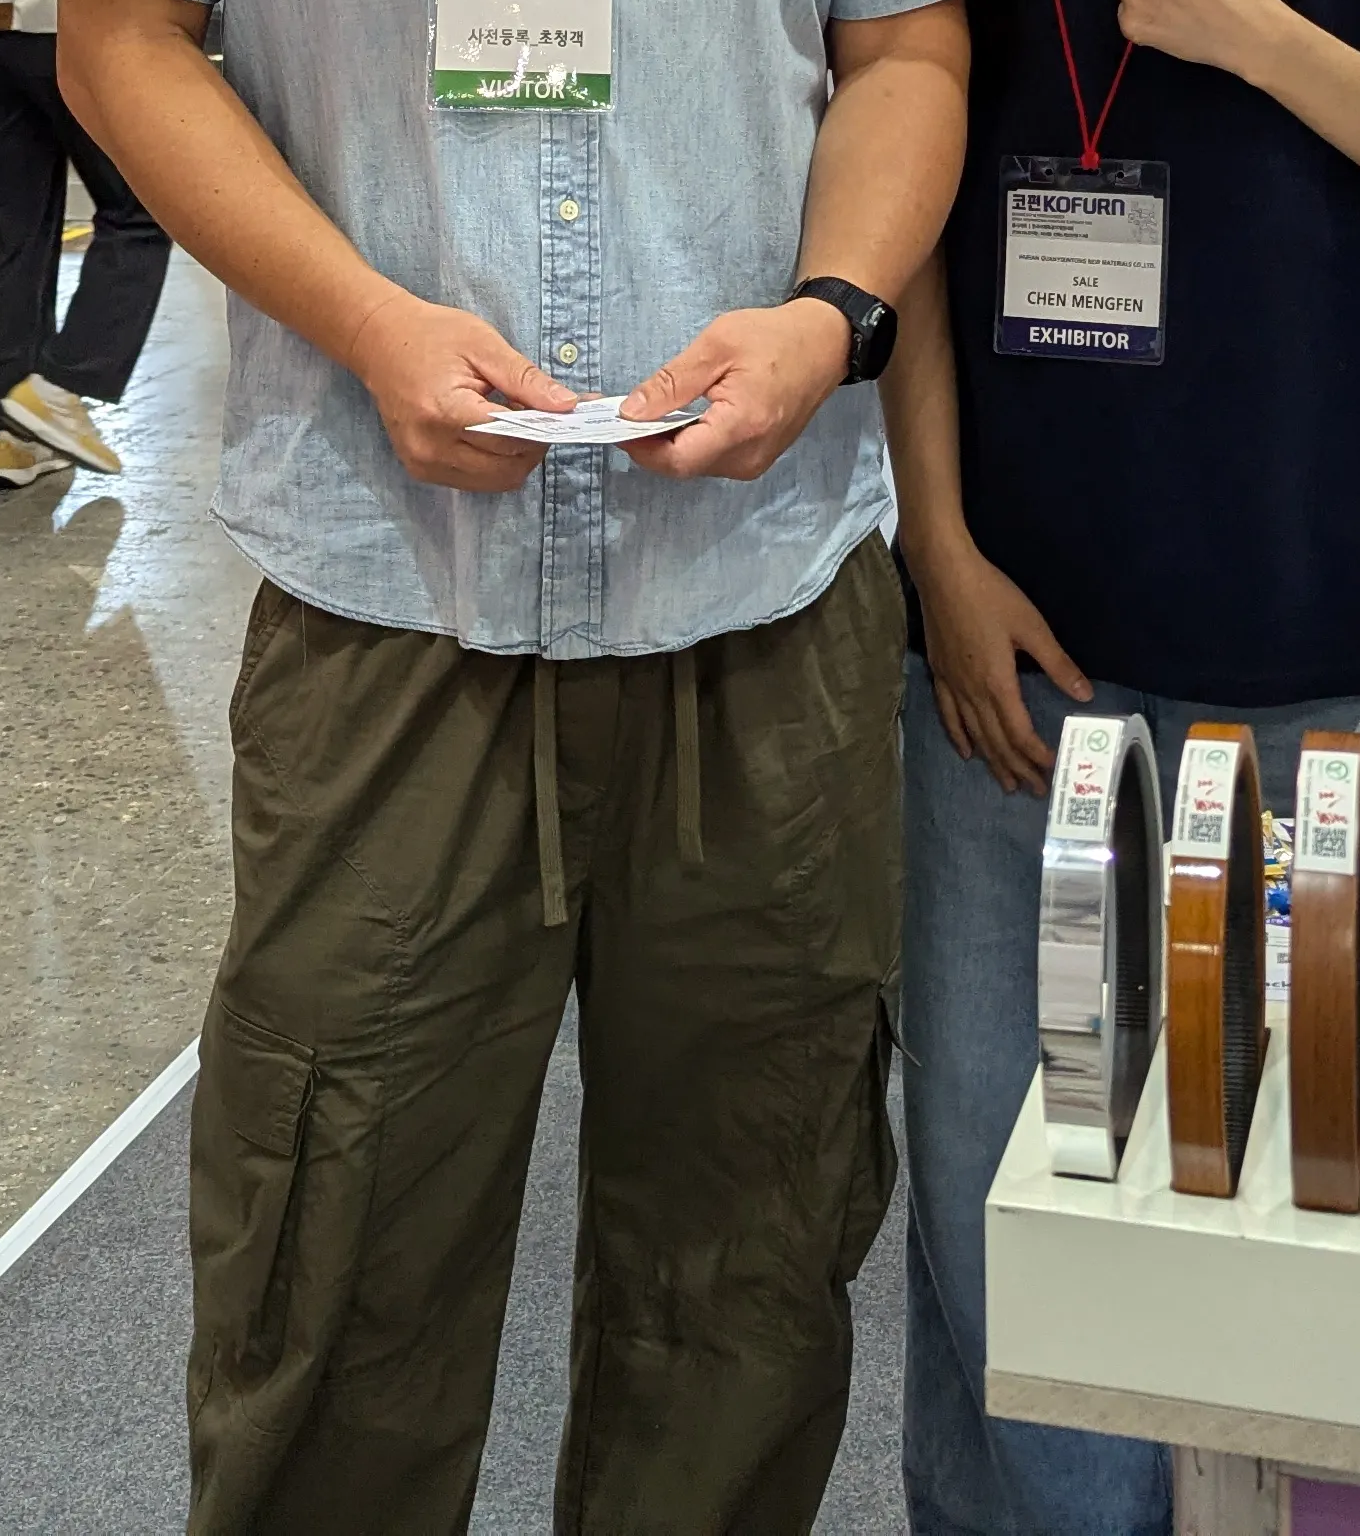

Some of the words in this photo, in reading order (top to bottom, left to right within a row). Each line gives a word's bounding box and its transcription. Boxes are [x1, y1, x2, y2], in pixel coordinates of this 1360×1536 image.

[467, 27, 585, 48] 사전등록_초청객
[479, 79, 566, 100] VISITOR
[1072, 276, 1100, 288] SALE
[1027, 291, 1067, 308] CHEN
[1071, 294, 1144, 313] MENGFEN
[1028, 326, 1130, 350] EXHIBITOR
